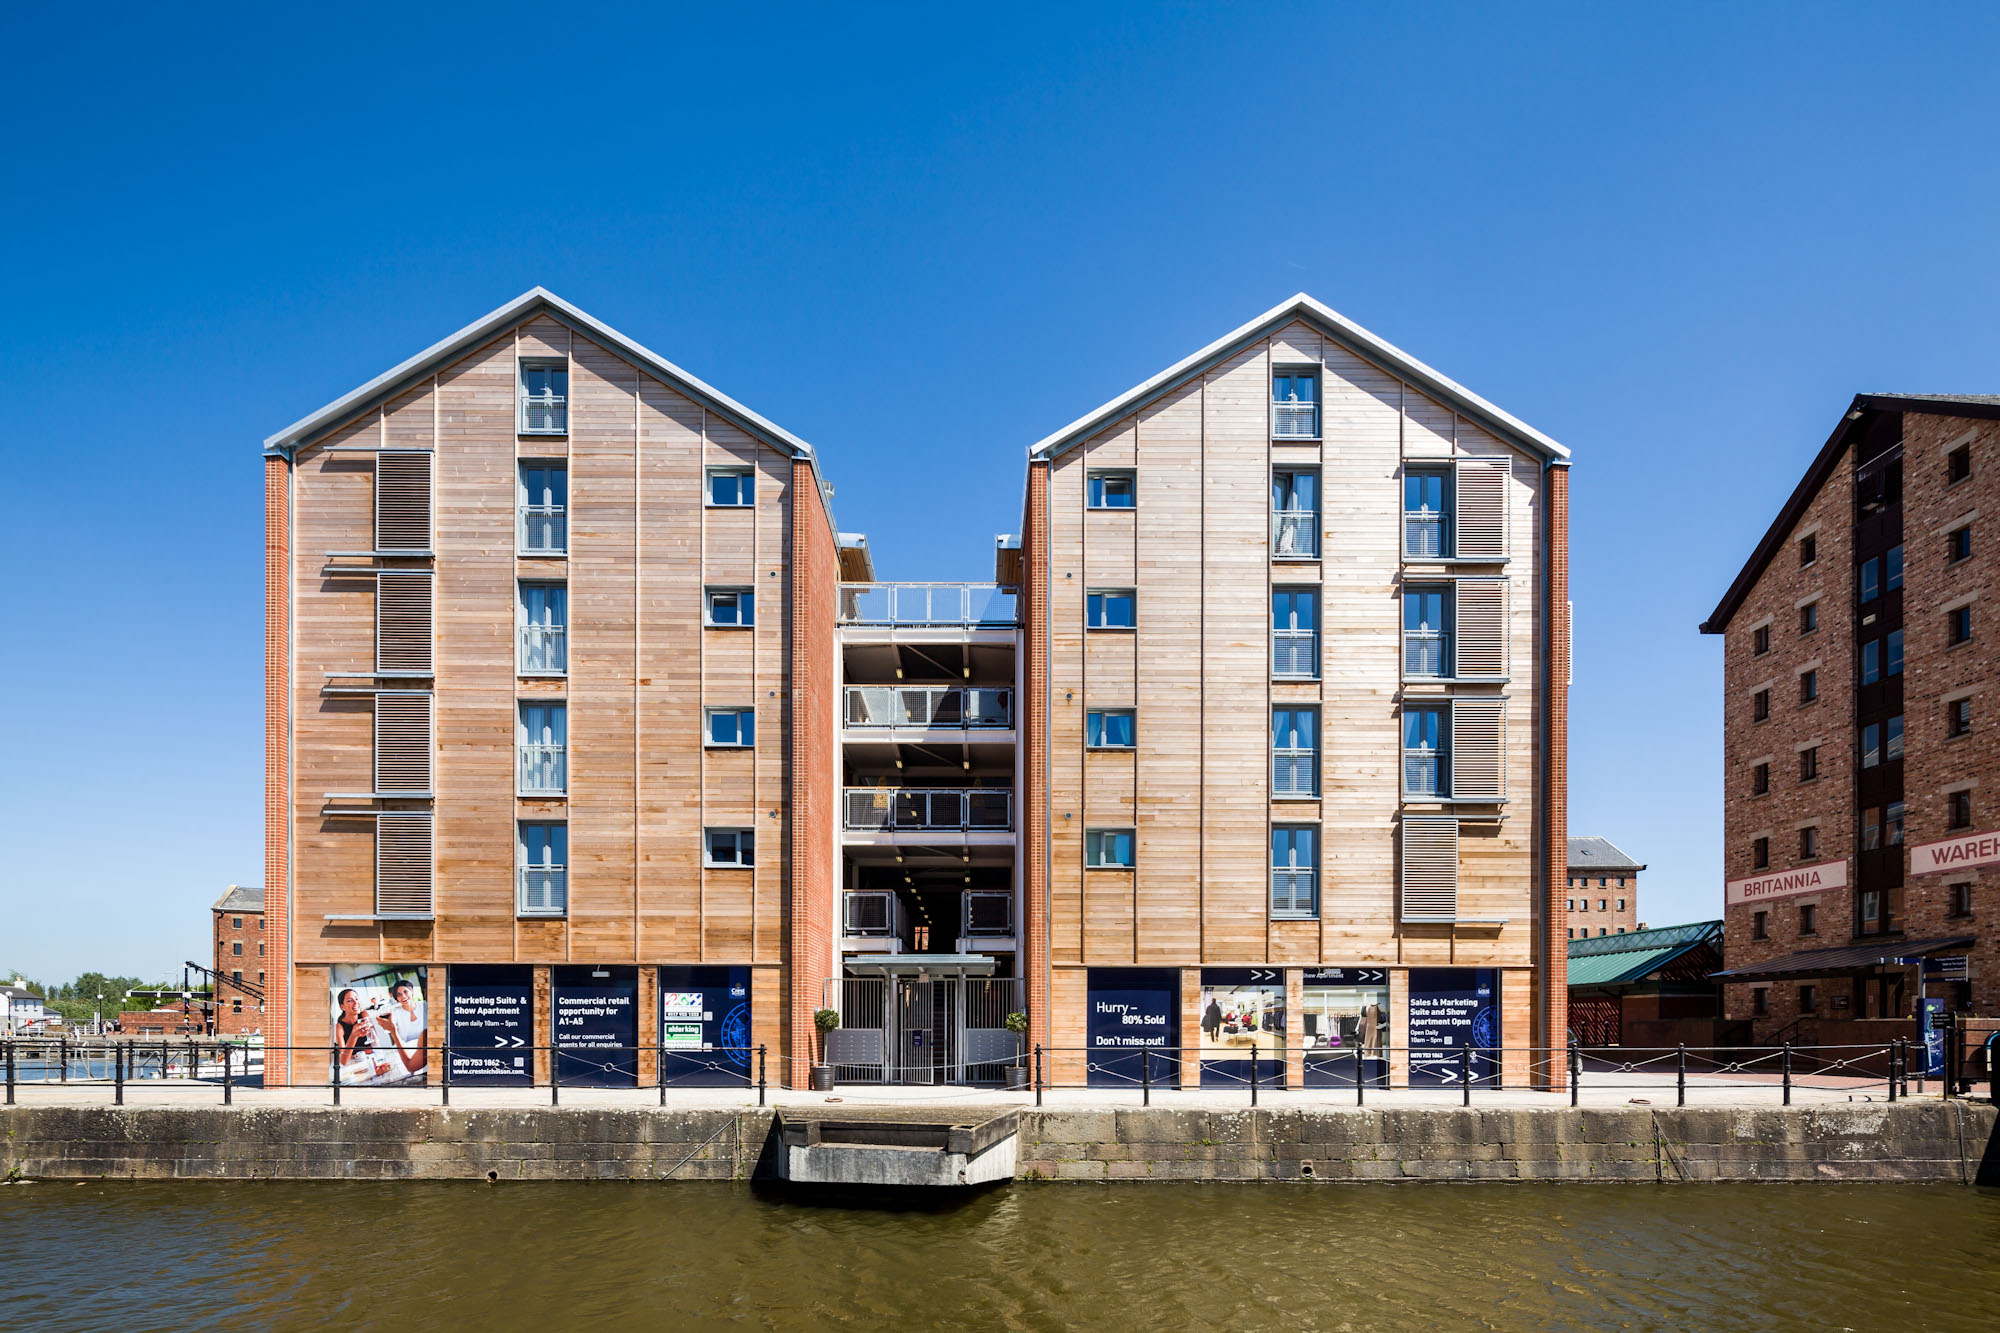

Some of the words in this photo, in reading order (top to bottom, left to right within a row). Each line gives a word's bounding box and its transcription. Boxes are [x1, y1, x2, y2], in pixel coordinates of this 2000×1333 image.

[1744, 871, 1821, 897] BRITANNIA
[454, 996, 495, 1006] Marketing
[495, 996, 517, 1005] Suite
[519, 996, 527, 1005] &
[558, 996, 607, 1005] Commercial
[607, 996, 630, 1005] retail
[1410, 998, 1432, 1007] Sales
[1431, 998, 1439, 1007] &
[1439, 998, 1479, 1008] Marketing
[453, 1006, 476, 1015] Show
[476, 1006, 520, 1017] Apartment
[558, 1006, 606, 1017] opportunity
[605, 1006, 619, 1016] for
[1096, 1001, 1129, 1016] Hurry
[1409, 1007, 1431, 1016] Suite
[1430, 1007, 1446, 1016] and
[1445, 1007, 1468, 1016] Show
[453, 1019, 470, 1028] Open
[469, 1019, 484, 1028] daily
[483, 1019, 500, 1027] 10am
[504, 1019, 519, 1028] 5pm
[558, 1017, 584, 1026] A1-A5
[1121, 1014, 1143, 1025] 80%
[1143, 1014, 1166, 1025] Sold
[1409, 1017, 1451, 1027] Apartment
[1451, 1017, 1472, 1027] Open
[667, 1025, 684, 1033] alder
[684, 1026, 699, 1034] king
[1409, 1029, 1425, 1037] Open
[1424, 1029, 1439, 1037] Daily
[1095, 1035, 1122, 1046] Don't
[1122, 1035, 1145, 1046] miss
[1145, 1035, 1165, 1046] out!
[1410, 1036, 1426, 1044] 10am
[1429, 1036, 1443, 1045] 5pm
[452, 1058, 470, 1068] 0870
[469, 1058, 484, 1067] 753
[483, 1058, 501, 1068] 1862
